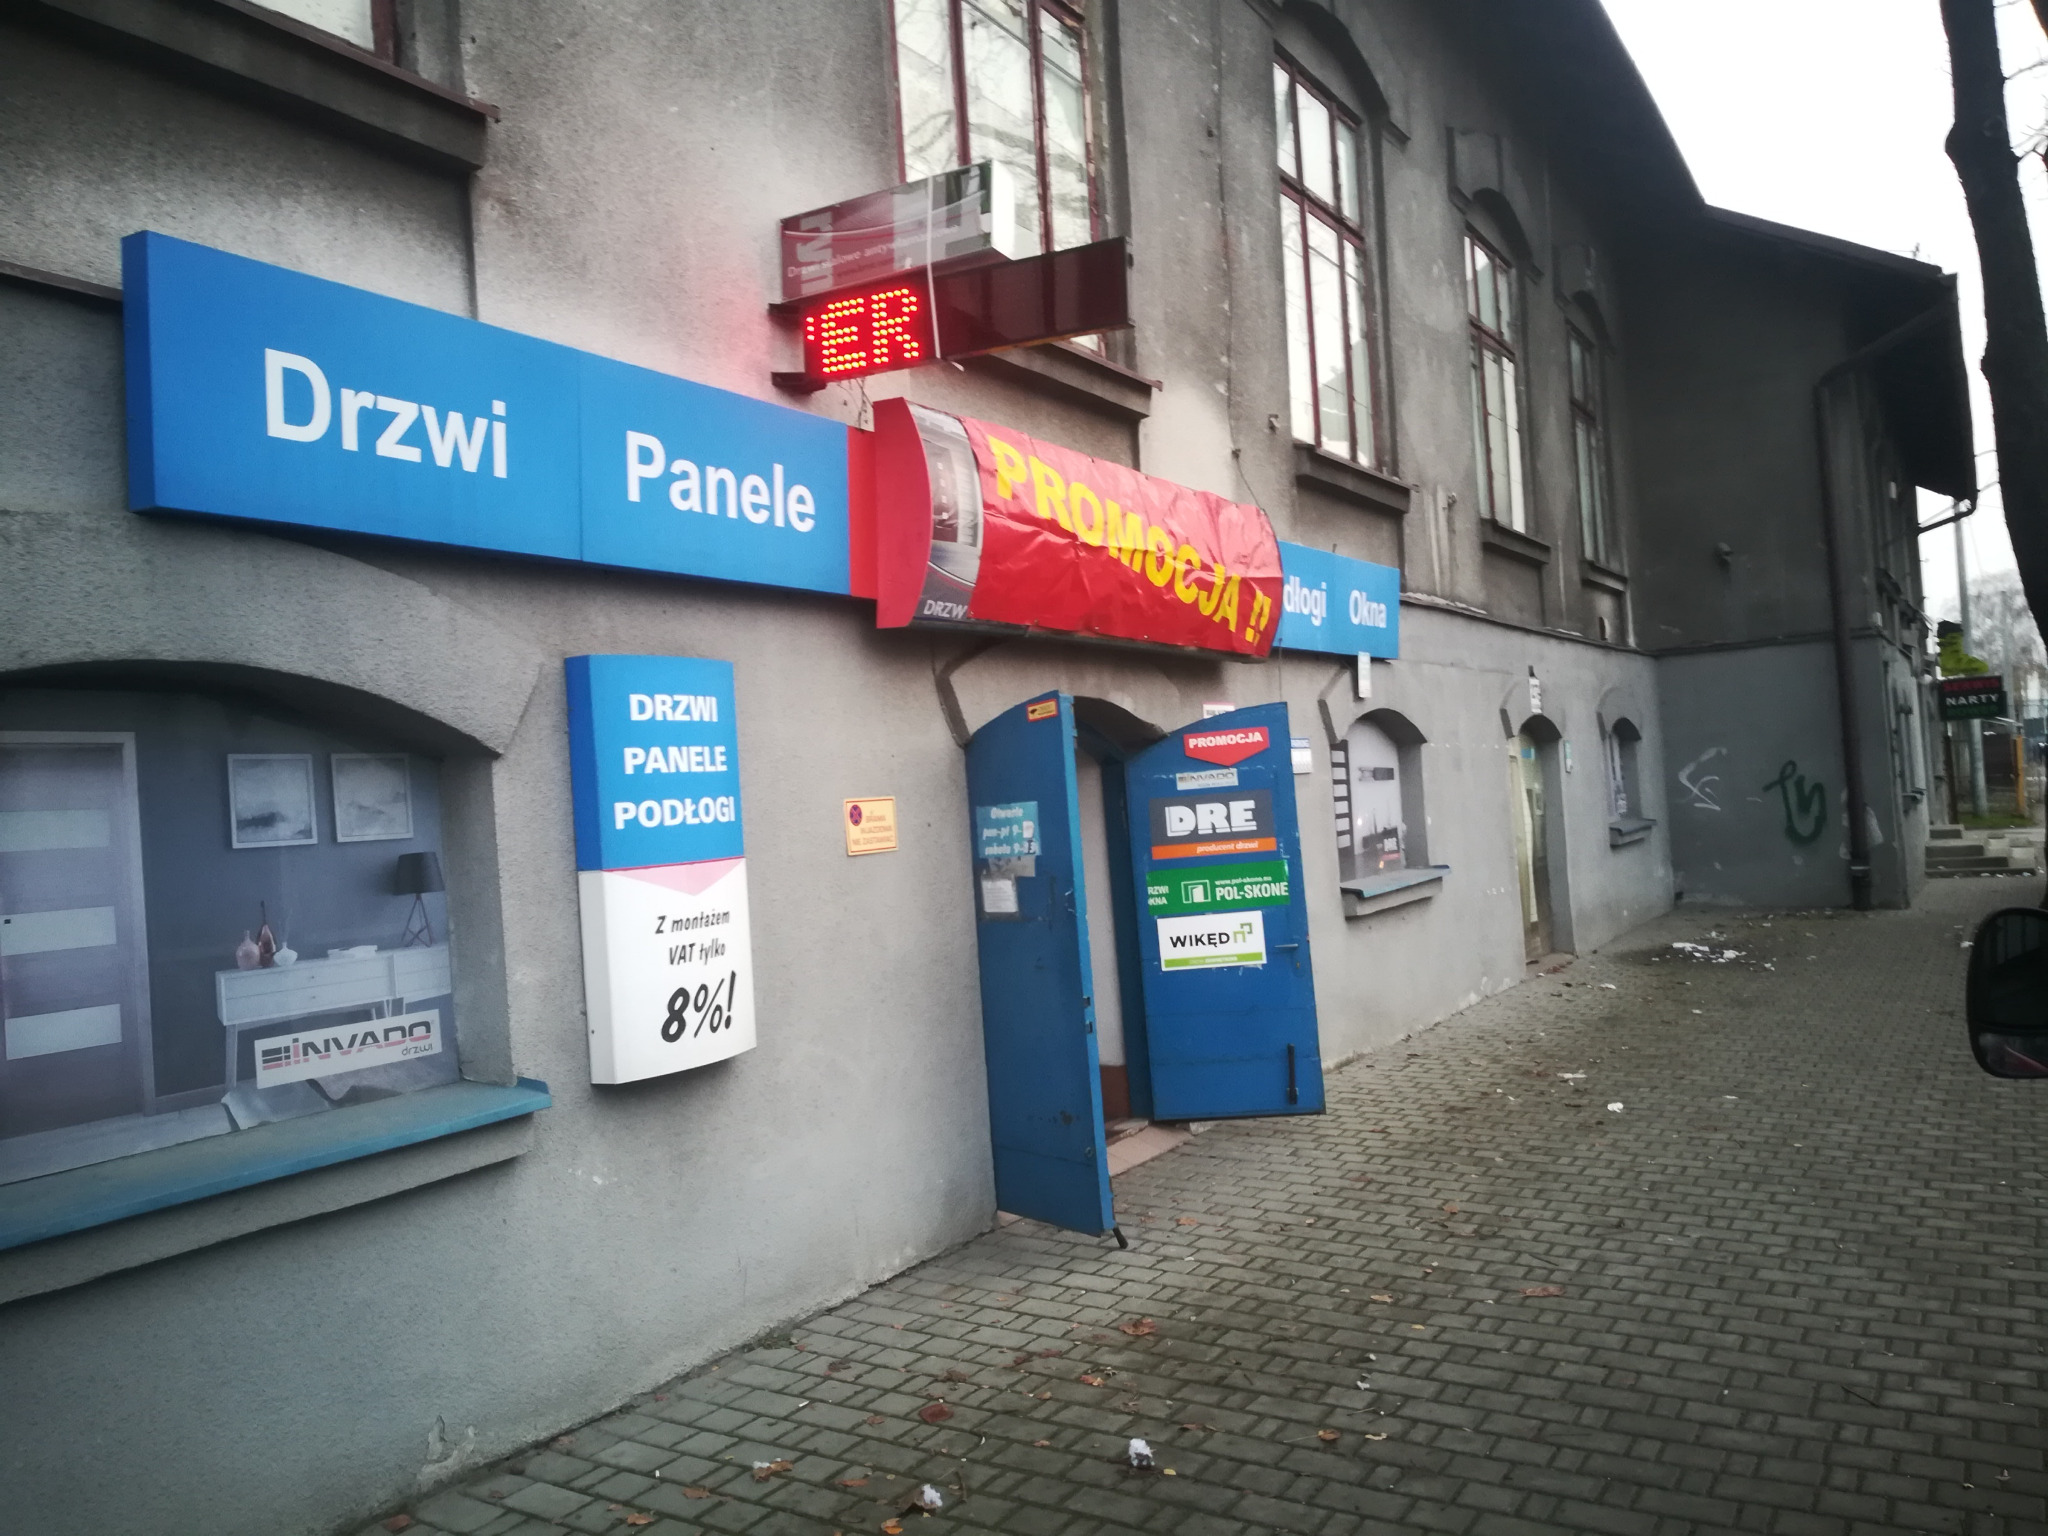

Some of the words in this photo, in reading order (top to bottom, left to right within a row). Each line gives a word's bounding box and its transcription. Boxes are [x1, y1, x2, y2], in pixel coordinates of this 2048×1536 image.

[806, 288, 919, 373] ER
[264, 348, 508, 479] Drzwi
[626, 430, 816, 532] Panele
[987, 434, 1241, 633] PROMOCJA
[1350, 589, 1387, 629] Okna
[629, 694, 718, 722] DRZWI
[1945, 693, 1999, 707] NARTY
[1188, 731, 1264, 749] PROMOCJA
[623, 745, 728, 775] PANELE
[614, 796, 736, 830] PODŁOGI
[1165, 800, 1257, 837] DRE
[1196, 843, 1235, 854] producent
[1235, 840, 1259, 849] drzwi
[1215, 881, 1289, 901] POL-SKONE
[655, 915, 667, 934] Z
[671, 908, 730, 933] montażem
[669, 942, 696, 965] VAT
[699, 937, 726, 965] tylko
[1170, 932, 1230, 948] WIKĘD
[661, 970, 737, 1043] 8%!
[401, 1043, 433, 1056] drzwi
